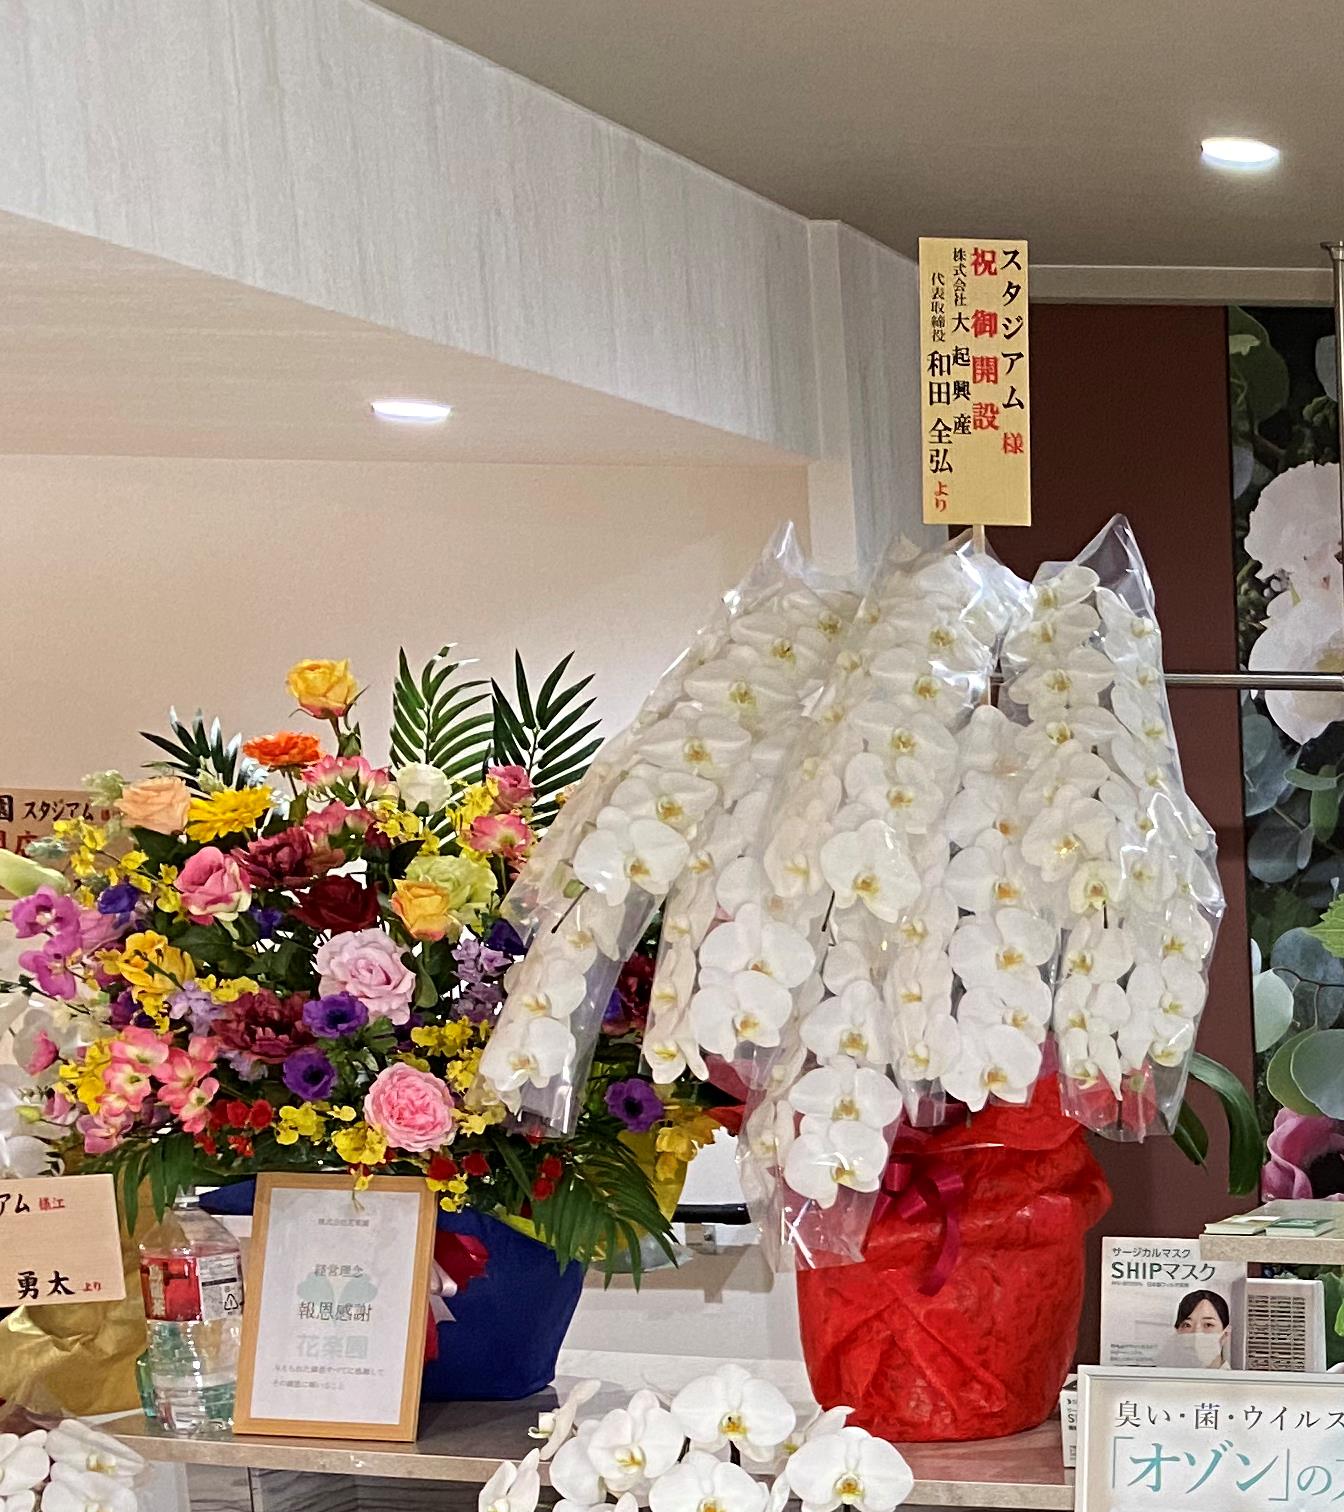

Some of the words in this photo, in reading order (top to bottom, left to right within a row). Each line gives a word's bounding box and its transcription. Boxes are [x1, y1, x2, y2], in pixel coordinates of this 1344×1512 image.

[953, 246, 967, 307] 株式会社
[970, 247, 998, 276] 祝
[930, 272, 945, 342] 代表取締役
[1000, 248, 1025, 412] スタジアム
[927, 349, 952, 406] 和田
[951, 311, 972, 436] 大起興産
[971, 308, 1000, 431] 御開設
[928, 416, 953, 474] 全弘
[1001, 431, 1025, 455] 様
[934, 479, 948, 513] より
[1112, 1248, 1191, 1259] サージカルマスク
[17, 1270, 75, 1299] 勇太
[299, 1301, 372, 1322] 報恩感謝
